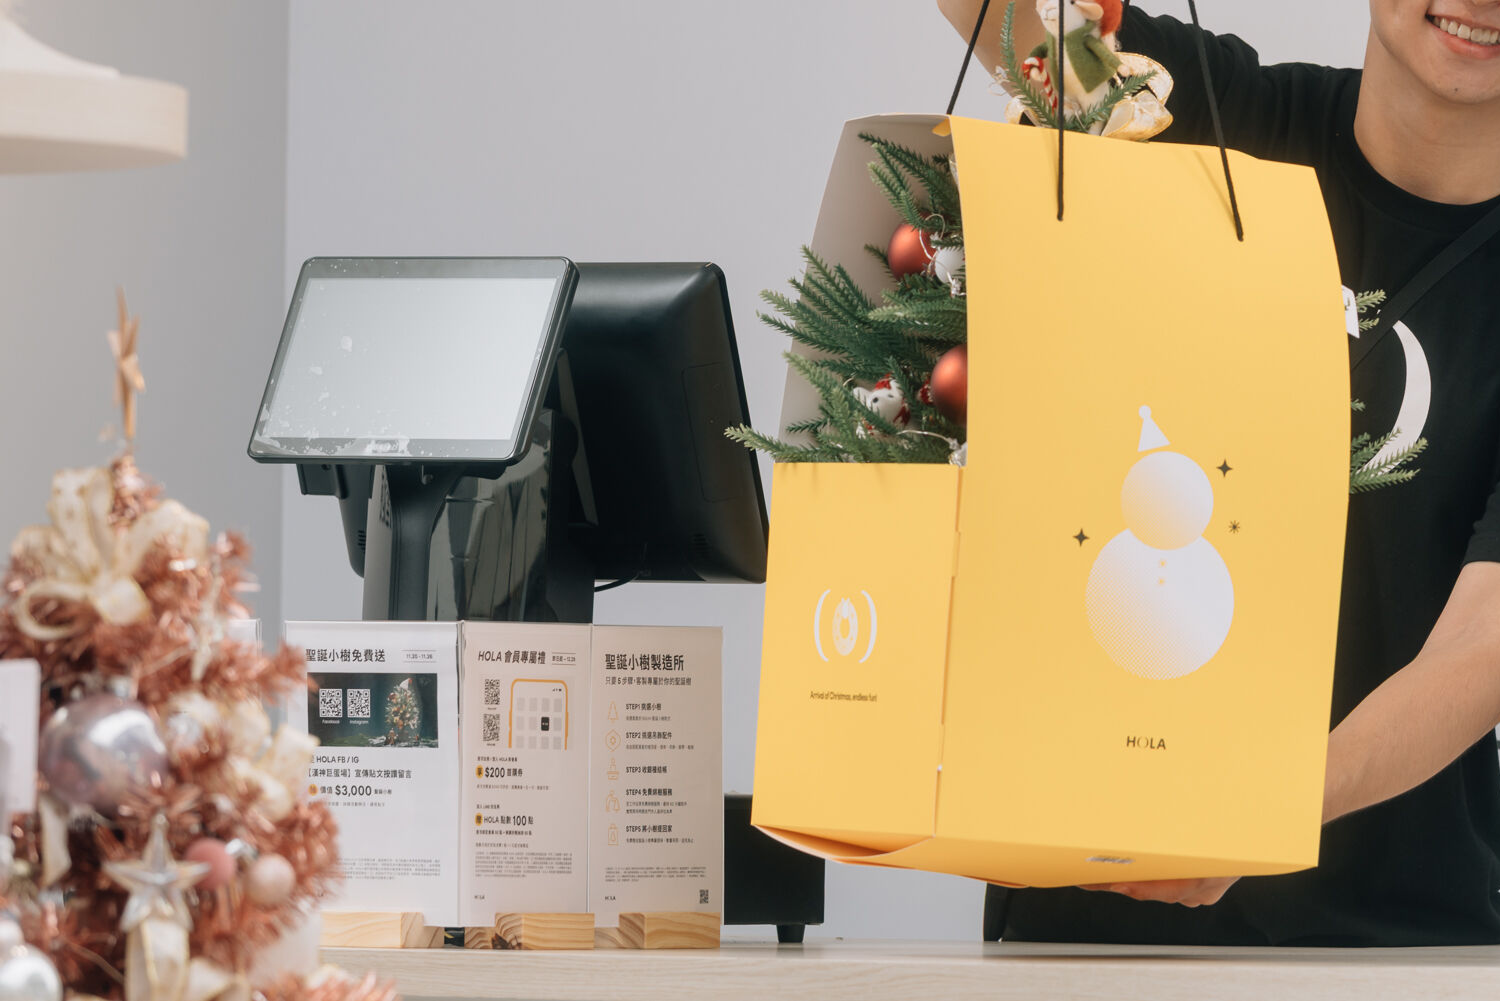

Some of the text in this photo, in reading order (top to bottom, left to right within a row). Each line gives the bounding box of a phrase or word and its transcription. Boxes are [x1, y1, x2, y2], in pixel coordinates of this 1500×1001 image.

[306, 649, 386, 662] 聖誕小樹免費送
[478, 650, 546, 665] HOLA 會員專屬禮
[605, 654, 684, 671] 聖誕小樹製造所
[1126, 736, 1167, 750] HOLA
[316, 755, 337, 764] HOLA
[337, 755, 346, 764] FB
[351, 755, 360, 764] IG
[484, 766, 506, 778] $200
[334, 785, 372, 797] $3,000
[625, 788, 642, 796] STEP4
[512, 815, 527, 826] 100
